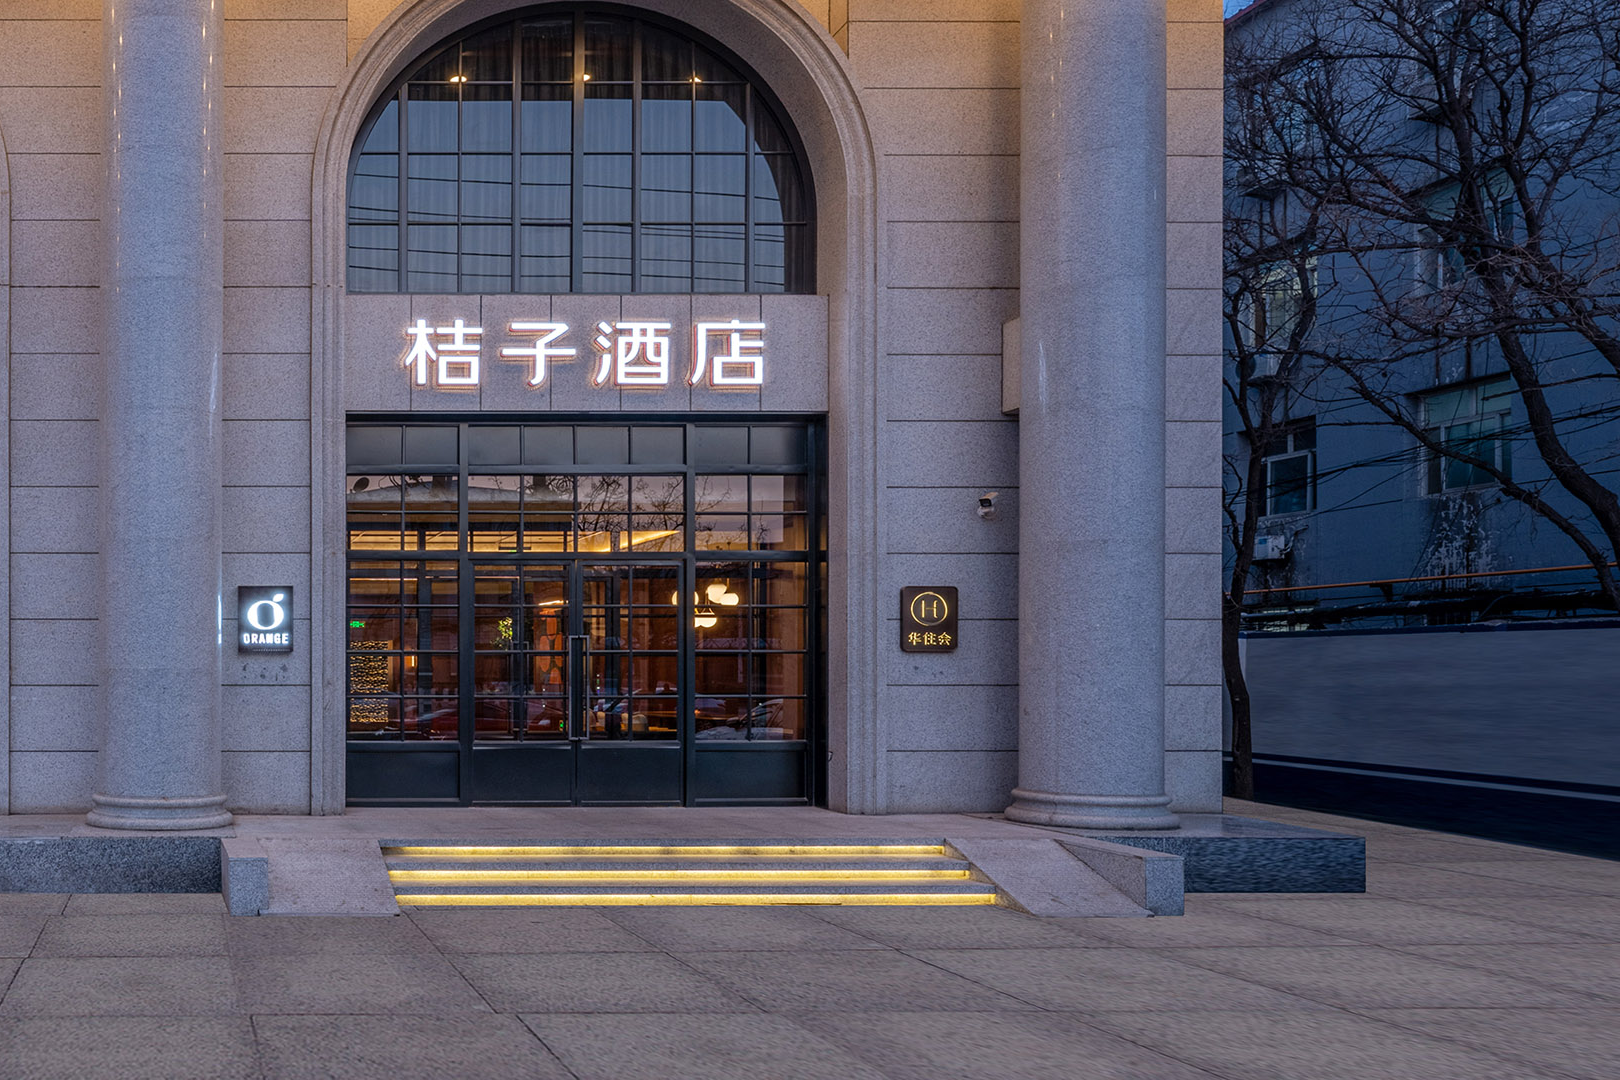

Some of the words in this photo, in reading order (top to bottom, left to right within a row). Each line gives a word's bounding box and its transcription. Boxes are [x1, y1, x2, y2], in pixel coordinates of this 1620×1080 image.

[405, 319, 766, 385] 桔子酒店
[243, 633, 289, 644] ORANGE
[908, 632, 952, 646] 华住会
